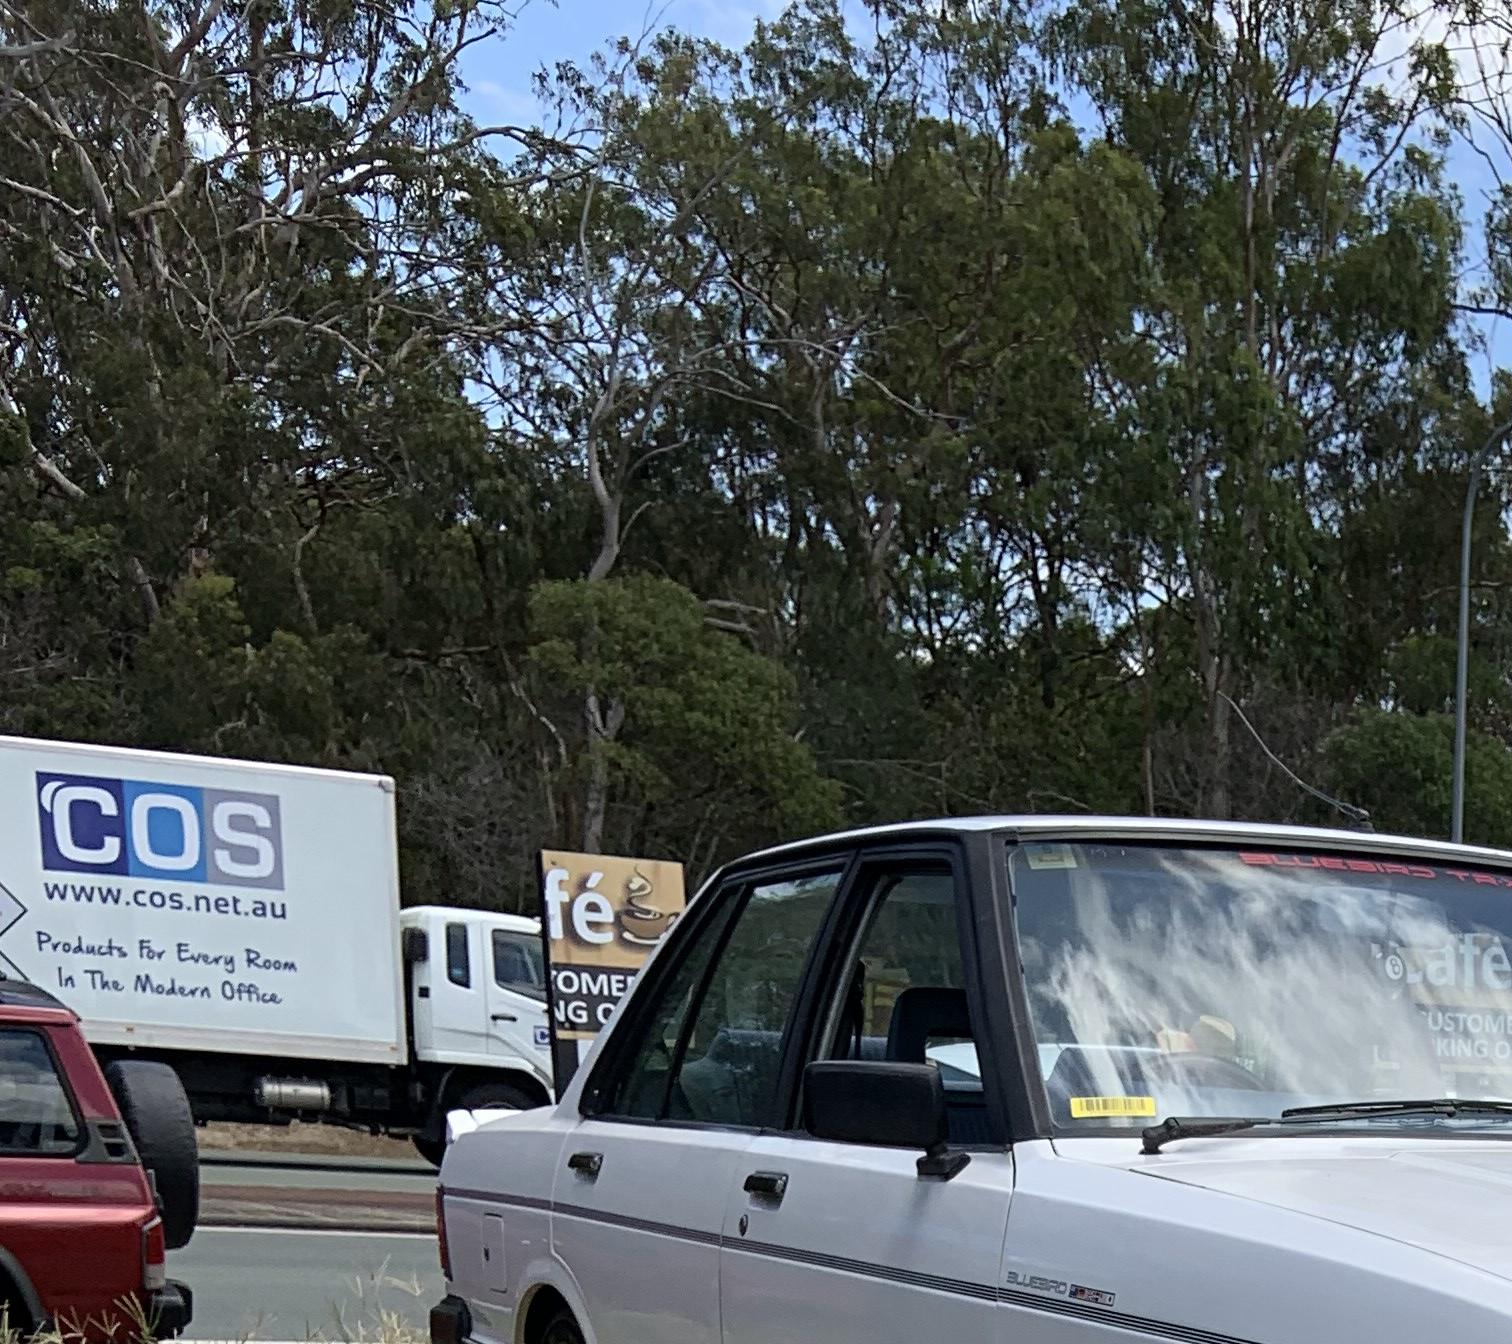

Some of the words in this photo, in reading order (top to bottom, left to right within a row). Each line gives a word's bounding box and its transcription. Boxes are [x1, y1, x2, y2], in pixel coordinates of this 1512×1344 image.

[41, 781, 275, 878] COS
[44, 882, 287, 919] www.cos.net.au
[36, 930, 128, 959] Products
[139, 939, 166, 961] For
[176, 943, 235, 974] Every
[245, 948, 298, 972] Room
[58, 966, 76, 988] In
[84, 969, 125, 992] The
[134, 974, 211, 999] Modern
[222, 980, 283, 1005] Office
